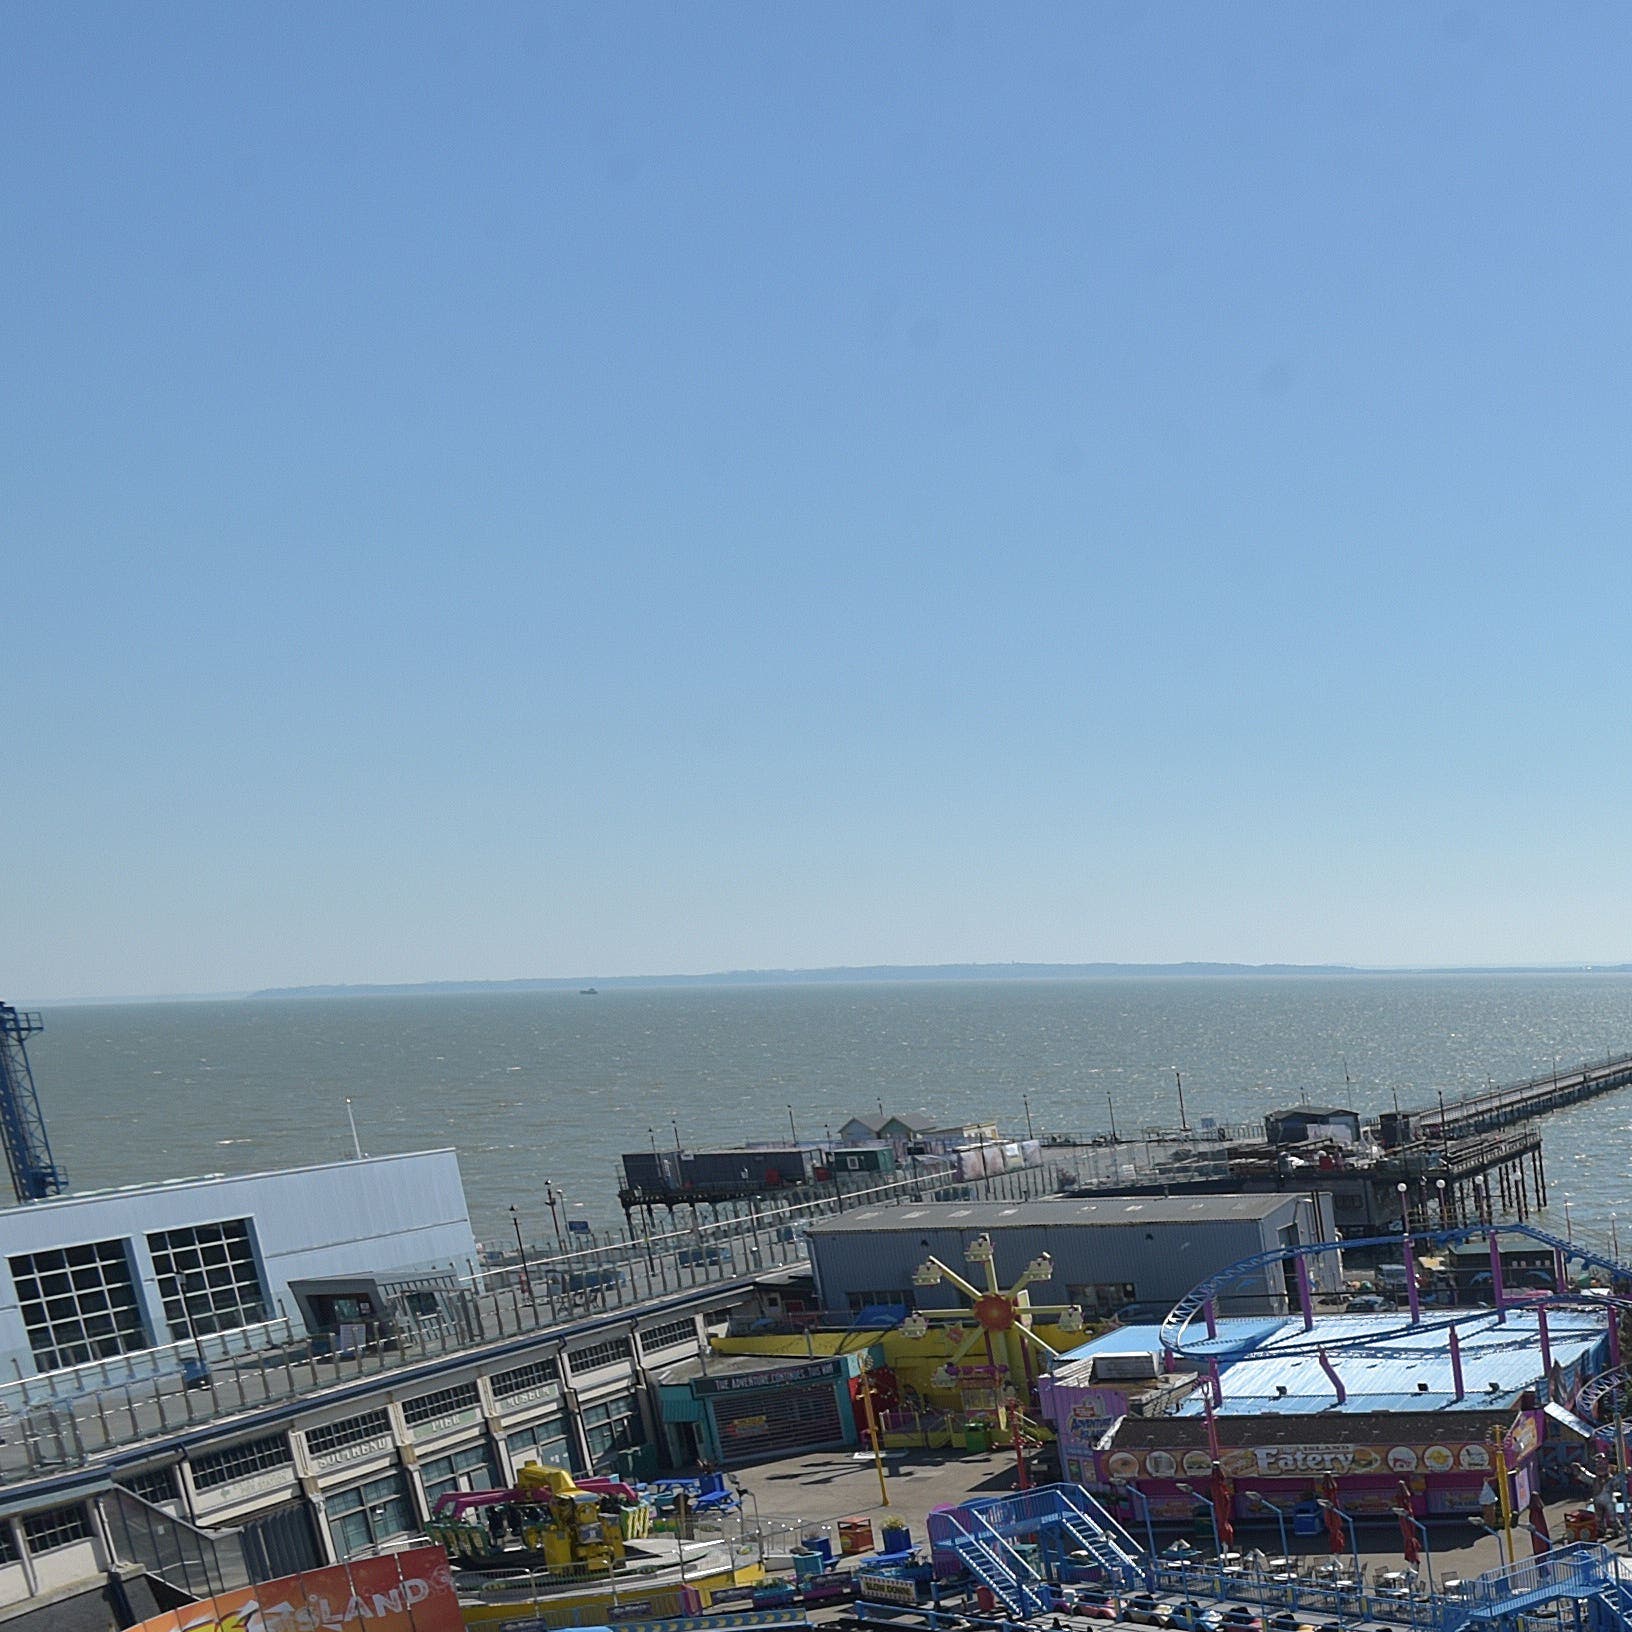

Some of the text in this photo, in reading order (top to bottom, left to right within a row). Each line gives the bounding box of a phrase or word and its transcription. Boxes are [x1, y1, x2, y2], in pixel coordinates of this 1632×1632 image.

[506, 1387, 550, 1407] MUSEUM
[431, 1414, 461, 1432] PIER
[318, 1437, 387, 1468] SOUTHEND
[1254, 1447, 1354, 1475] Eatery
